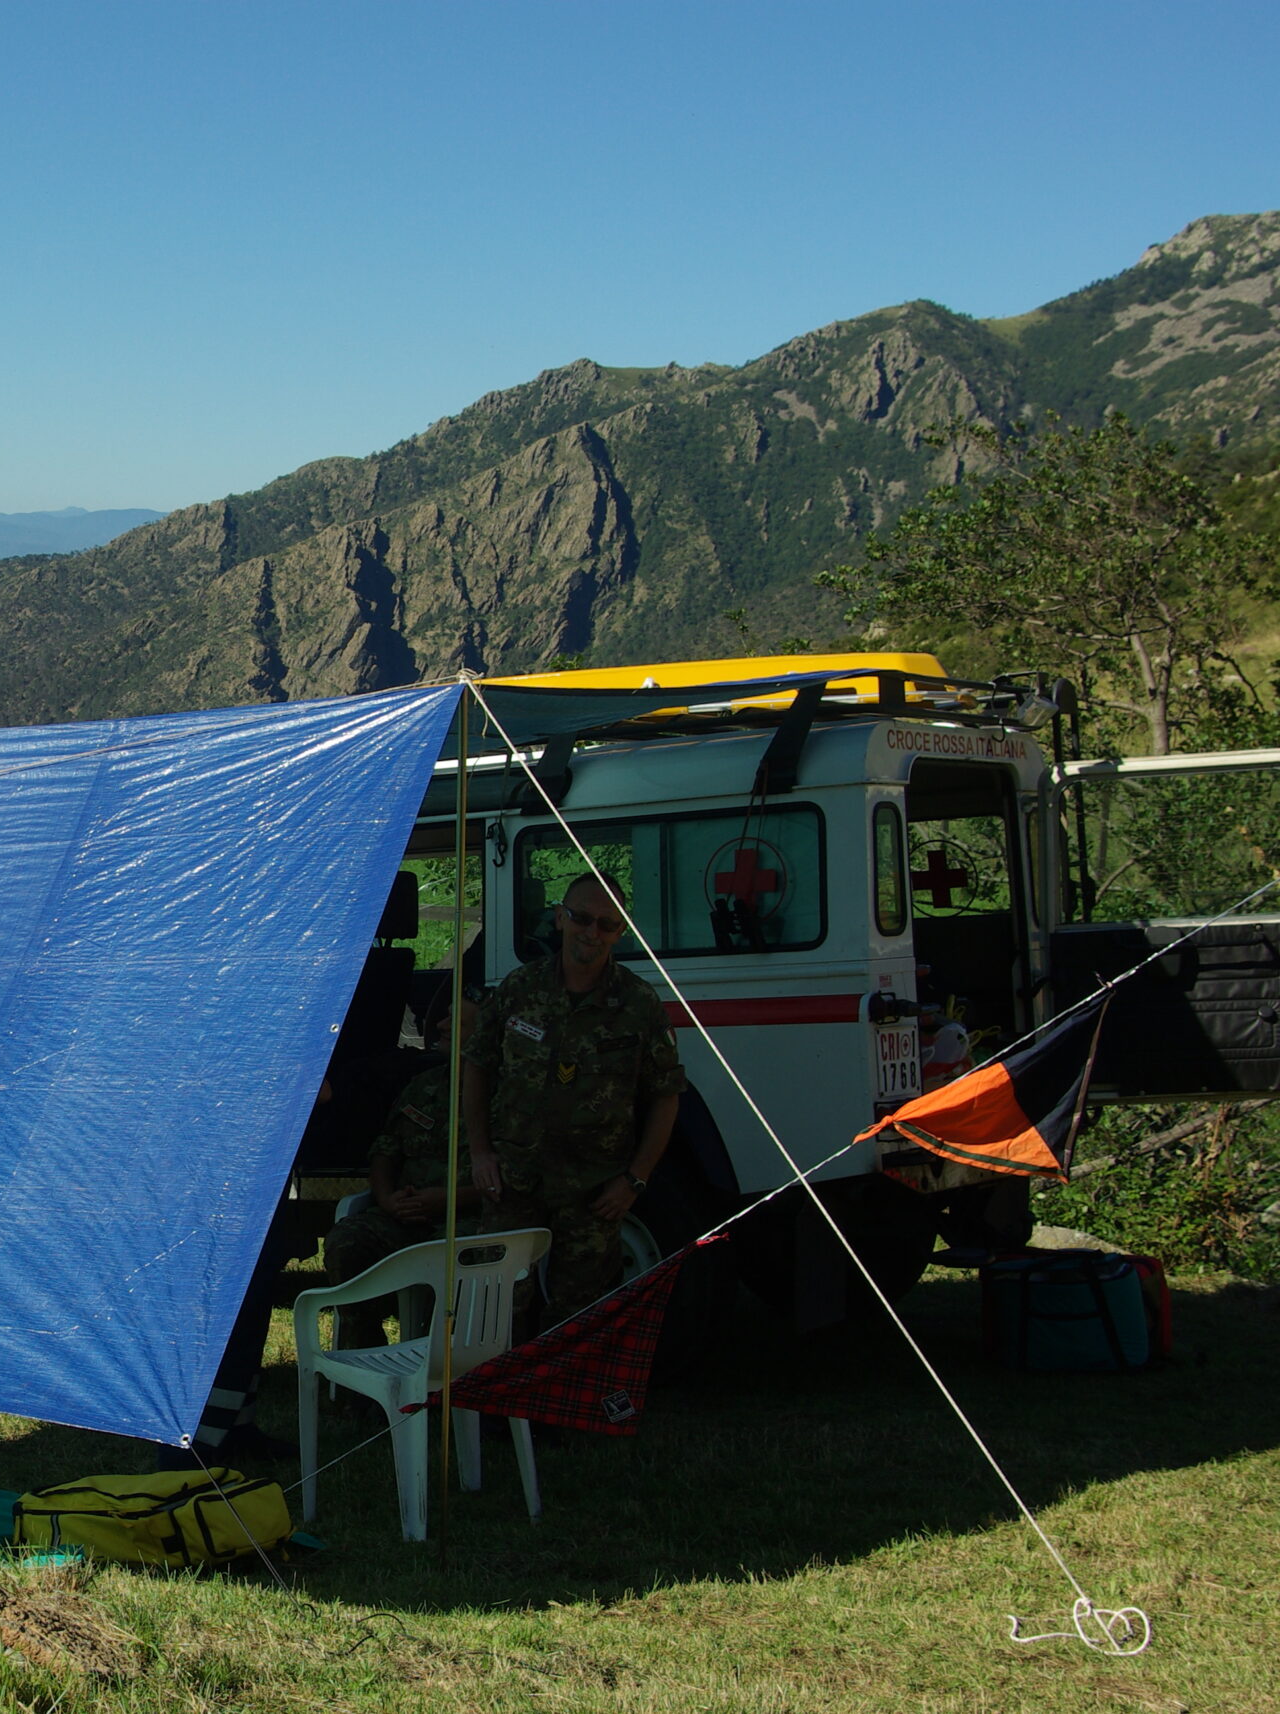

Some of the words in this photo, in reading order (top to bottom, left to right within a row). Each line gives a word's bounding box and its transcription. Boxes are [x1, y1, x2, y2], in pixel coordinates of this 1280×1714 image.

[886, 729, 930, 752] CROCE
[933, 733, 973, 755] ROSSA
[975, 736, 1028, 759] ITALIANA
[880, 1031, 900, 1061] CRI
[882, 1061, 917, 1093] 1768
